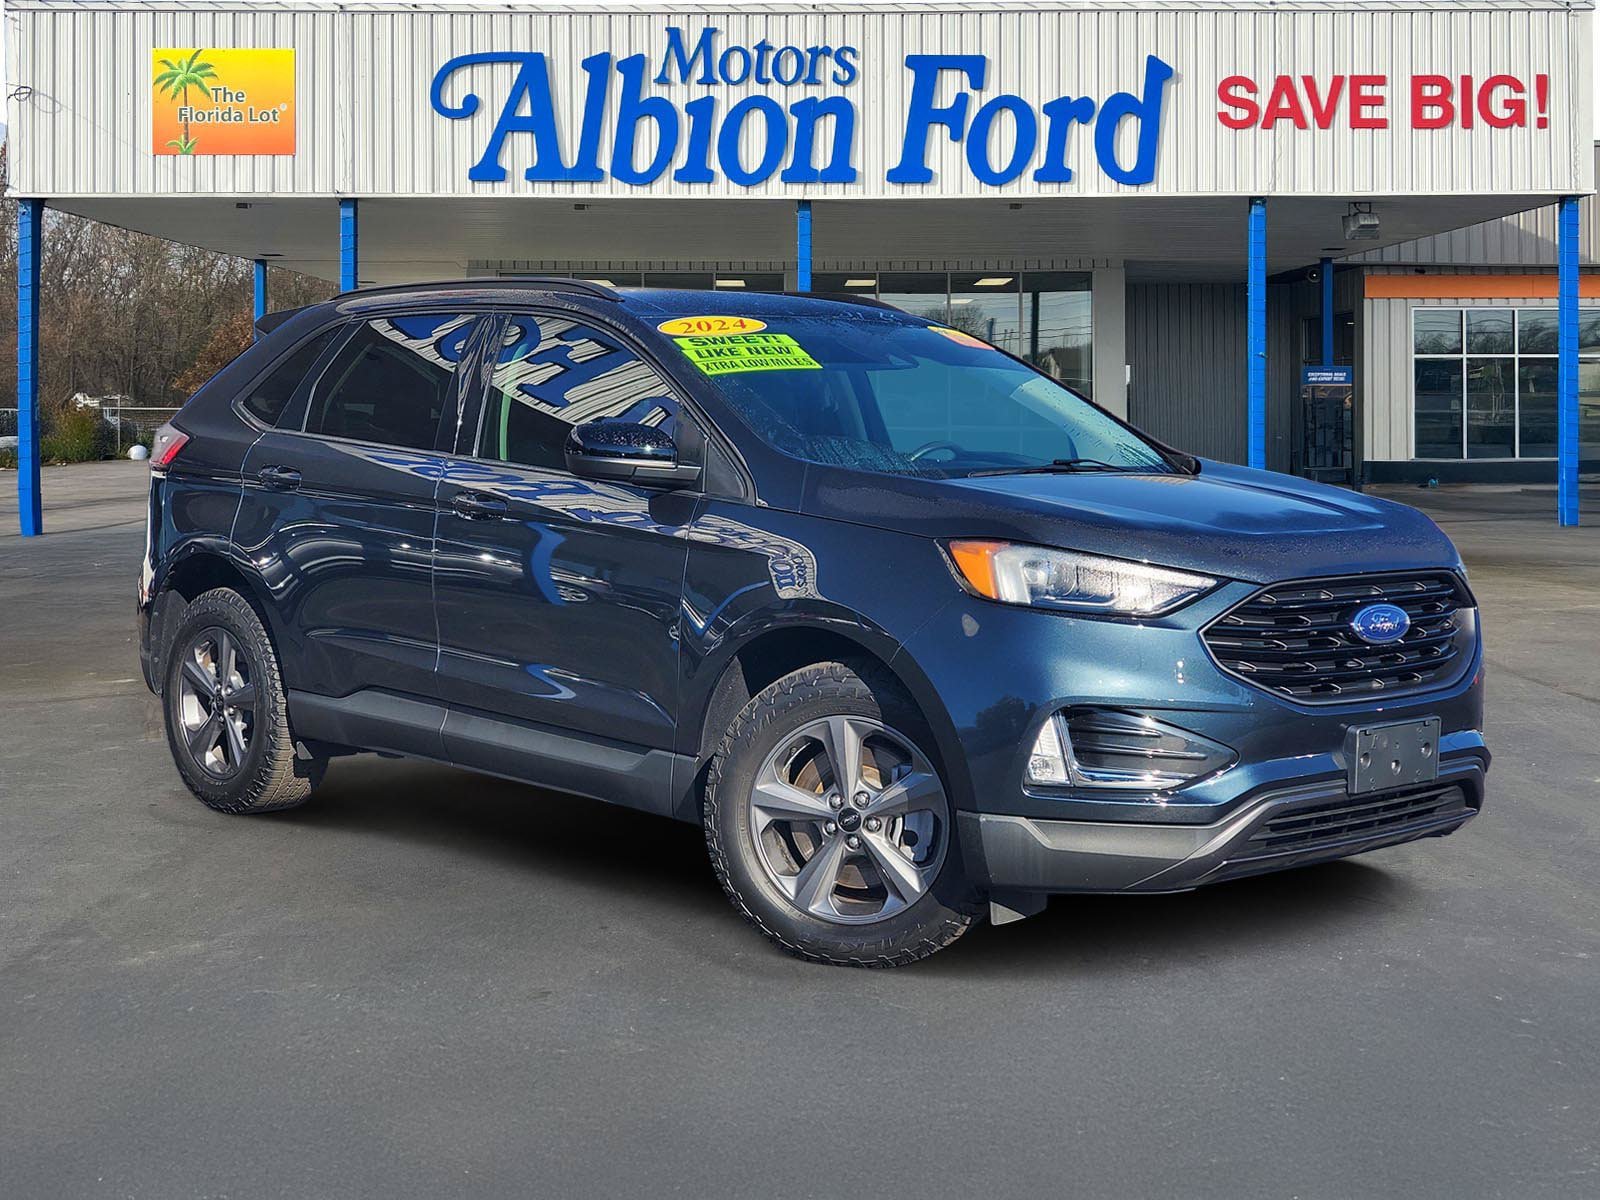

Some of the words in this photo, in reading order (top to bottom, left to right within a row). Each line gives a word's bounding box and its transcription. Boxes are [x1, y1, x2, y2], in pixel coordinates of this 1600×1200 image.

[655, 27, 857, 86] Motors
[211, 86, 245, 103] The
[1218, 75, 1388, 130] SAVE
[1411, 74, 1548, 129] BIG!
[178, 106, 243, 122] Florida
[249, 107, 279, 122] Lot
[430, 52, 858, 186] Albion
[886, 54, 1174, 186] Ford
[680, 319, 747, 334] 2024
[688, 335, 781, 346] SWEET!
[694, 348, 742, 359] LIKE
[745, 345, 792, 356] NEW
[701, 360, 737, 372] XTRA
